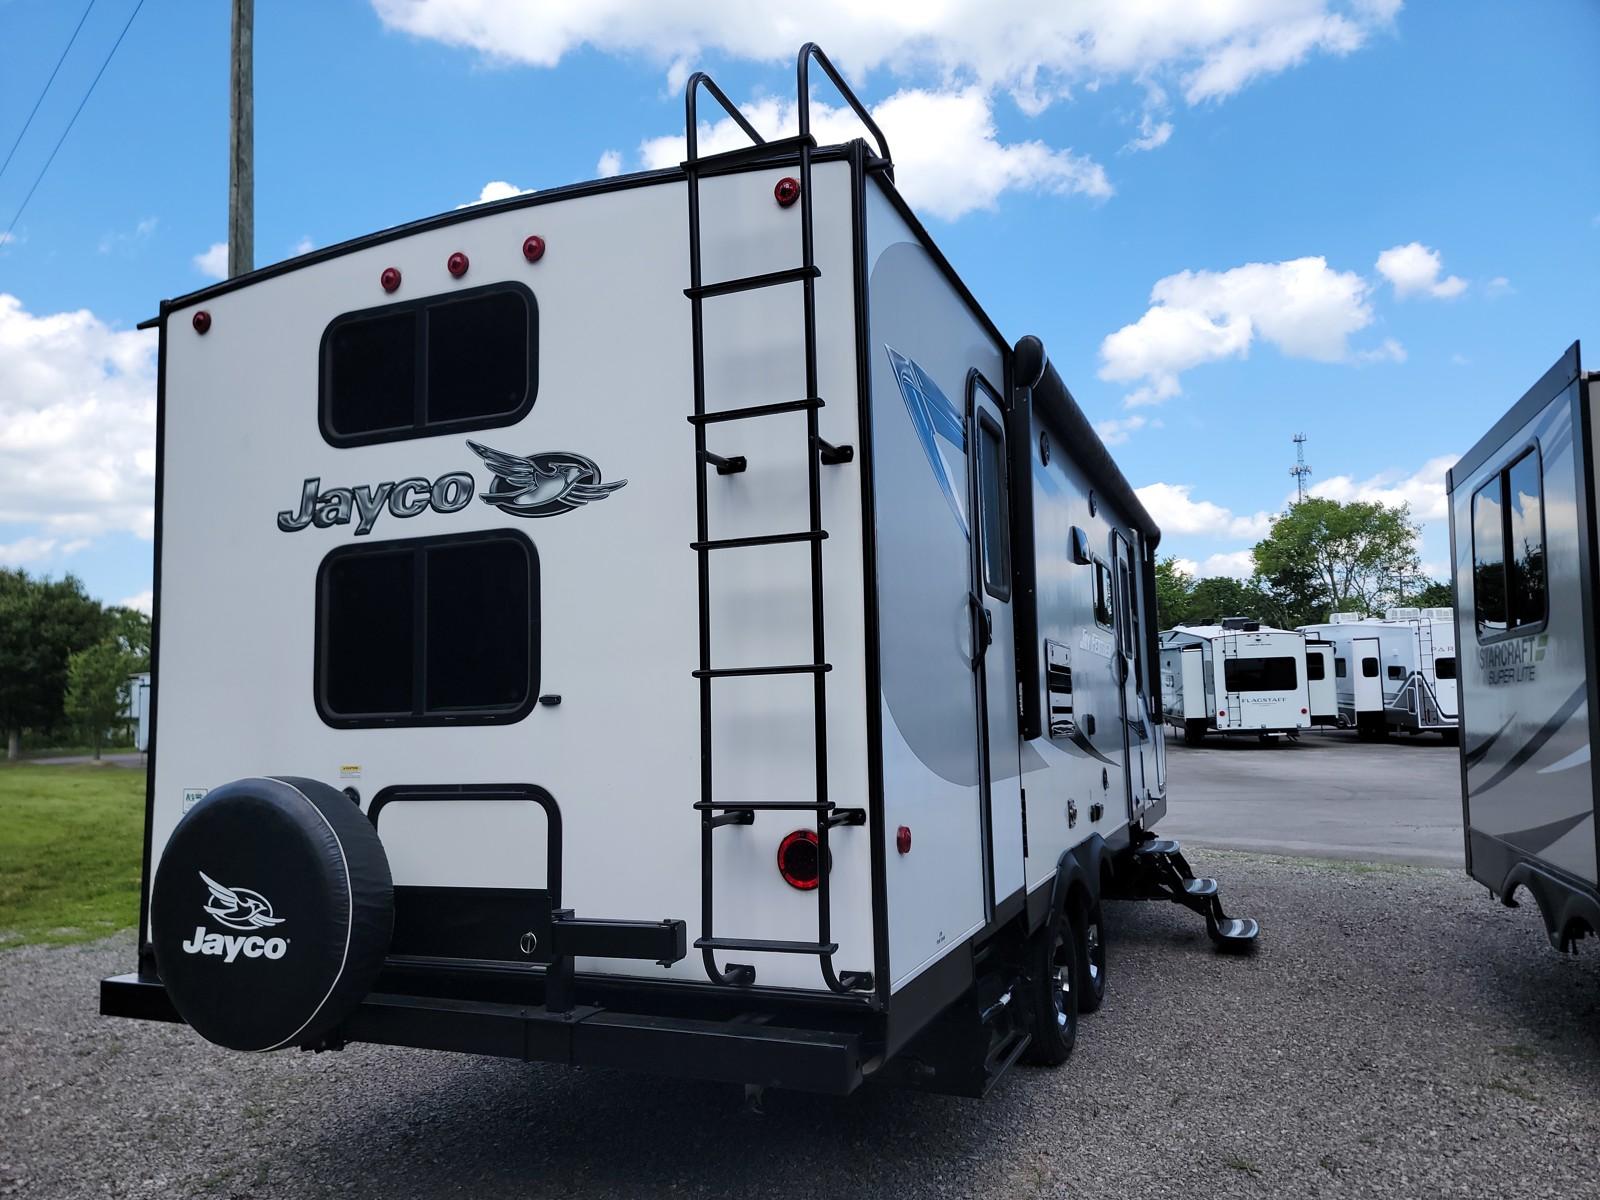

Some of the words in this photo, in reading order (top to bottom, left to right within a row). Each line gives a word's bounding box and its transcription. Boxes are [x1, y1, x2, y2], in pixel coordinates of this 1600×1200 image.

[277, 471, 475, 536] Jayco
[1480, 637, 1535, 670] STARCRAFT
[1488, 668, 1515, 685] SUPER
[1516, 666, 1535, 682] LITE
[183, 927, 287, 963] Jayco
